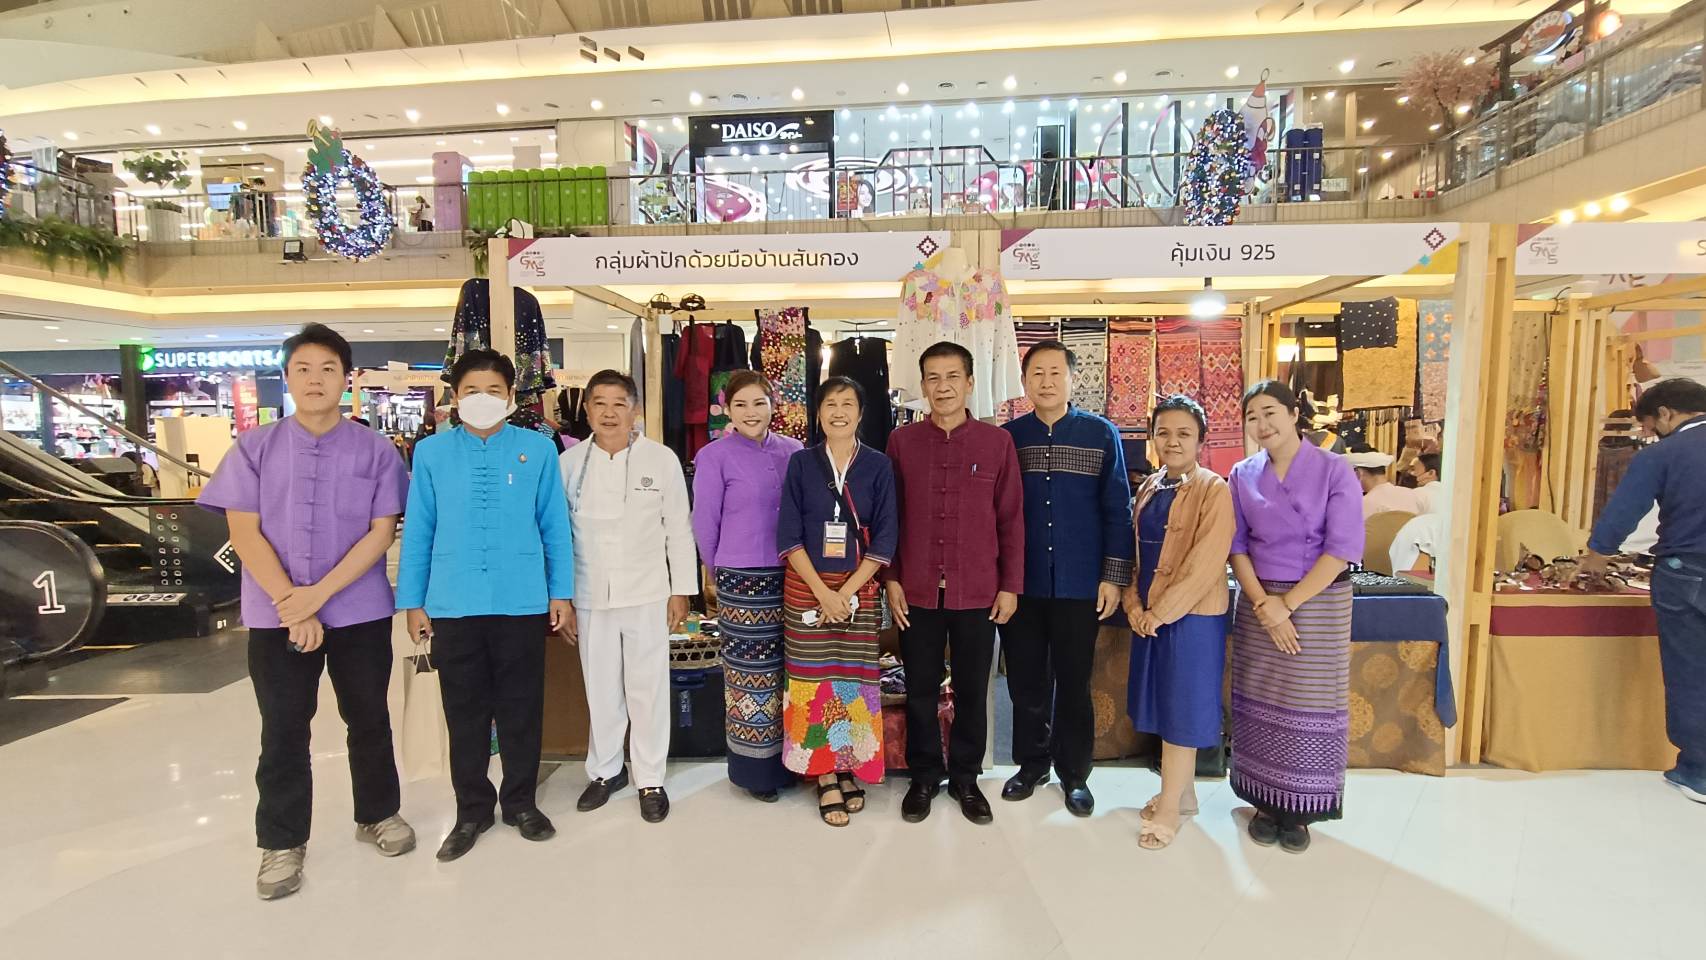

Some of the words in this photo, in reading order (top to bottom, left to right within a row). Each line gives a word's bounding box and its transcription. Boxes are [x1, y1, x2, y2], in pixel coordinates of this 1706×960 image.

[722, 121, 777, 139] DAISO
[594, 248, 859, 275] กลุ่มผ้าปักด้วยมือบ้านสันกอง
[1170, 242, 1231, 267] คุ้มเงิน
[1240, 244, 1276, 261] 925
[32, 570, 66, 615] 1
